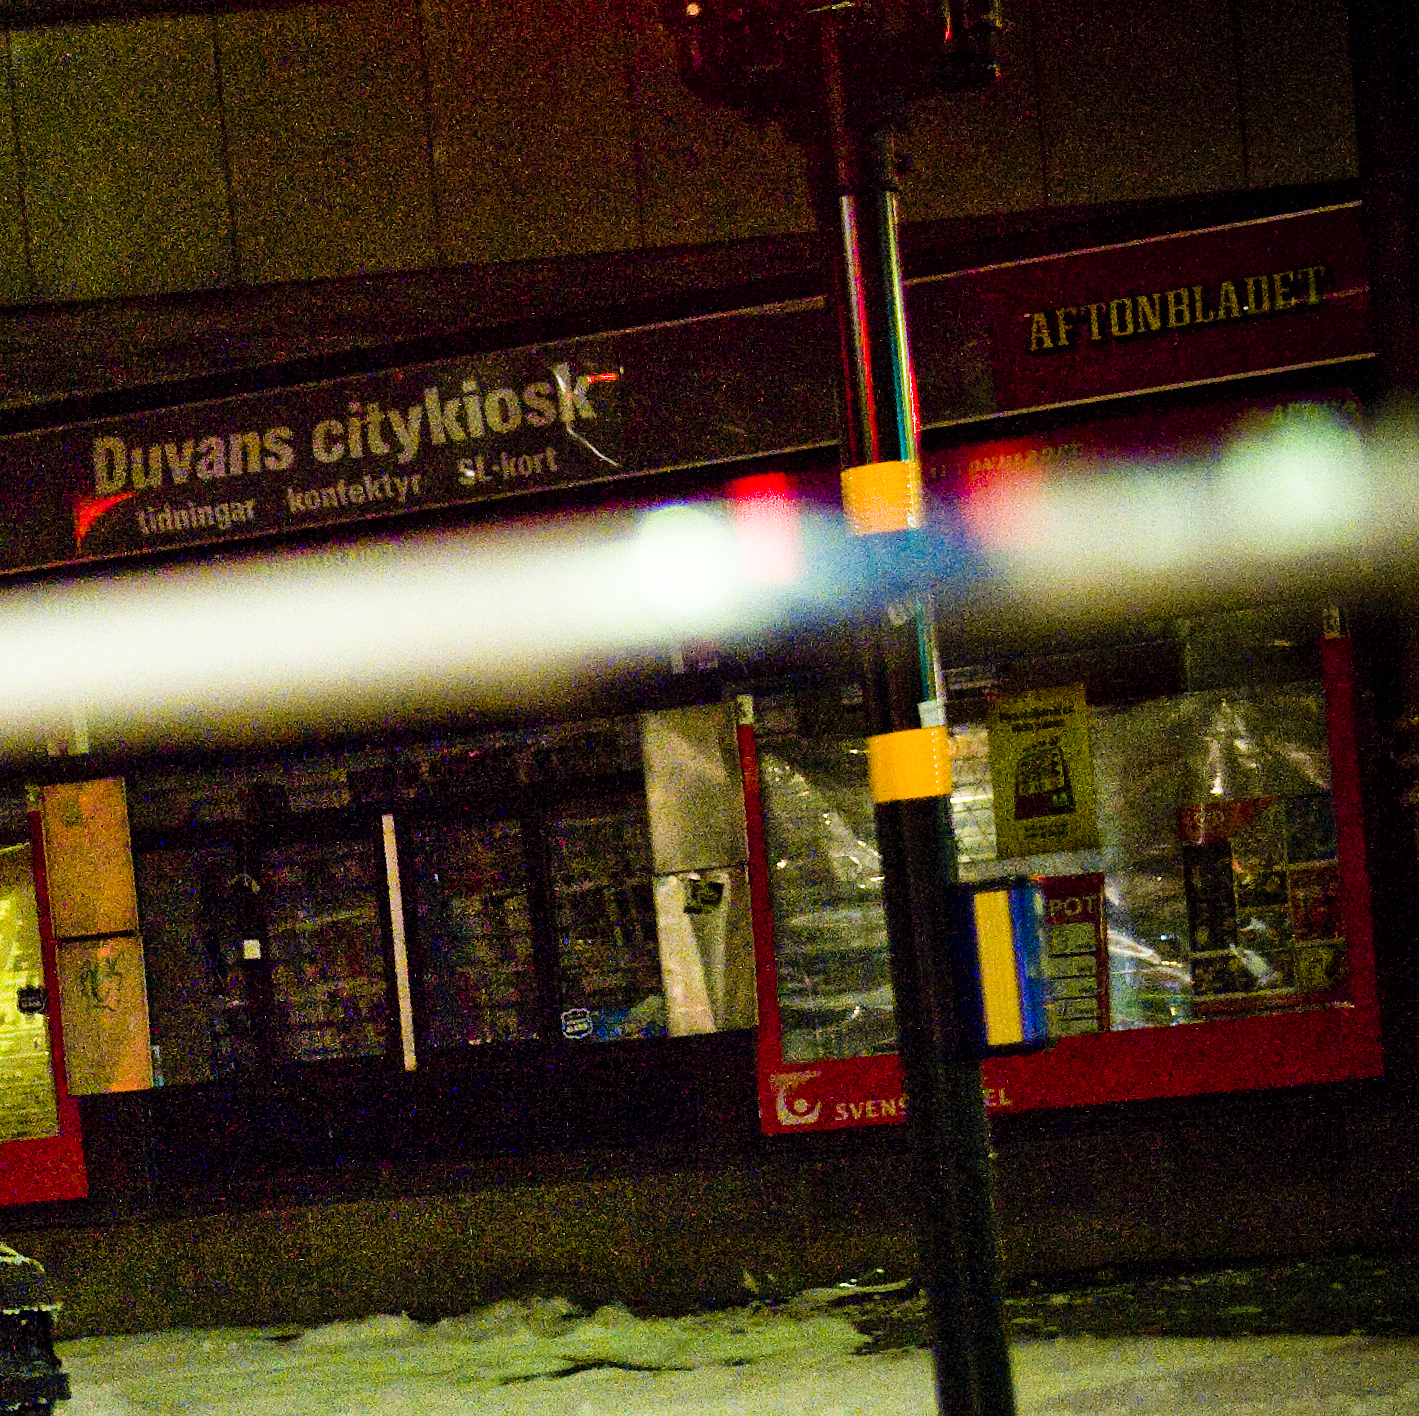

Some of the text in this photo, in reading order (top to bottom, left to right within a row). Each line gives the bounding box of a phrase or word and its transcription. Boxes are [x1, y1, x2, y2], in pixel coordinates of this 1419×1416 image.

[1029, 265, 1327, 352] AFTONBLADET
[92, 362, 597, 494] Duvans citykiosk
[135, 495, 256, 537] tidningar
[285, 470, 424, 516] konfektyr
